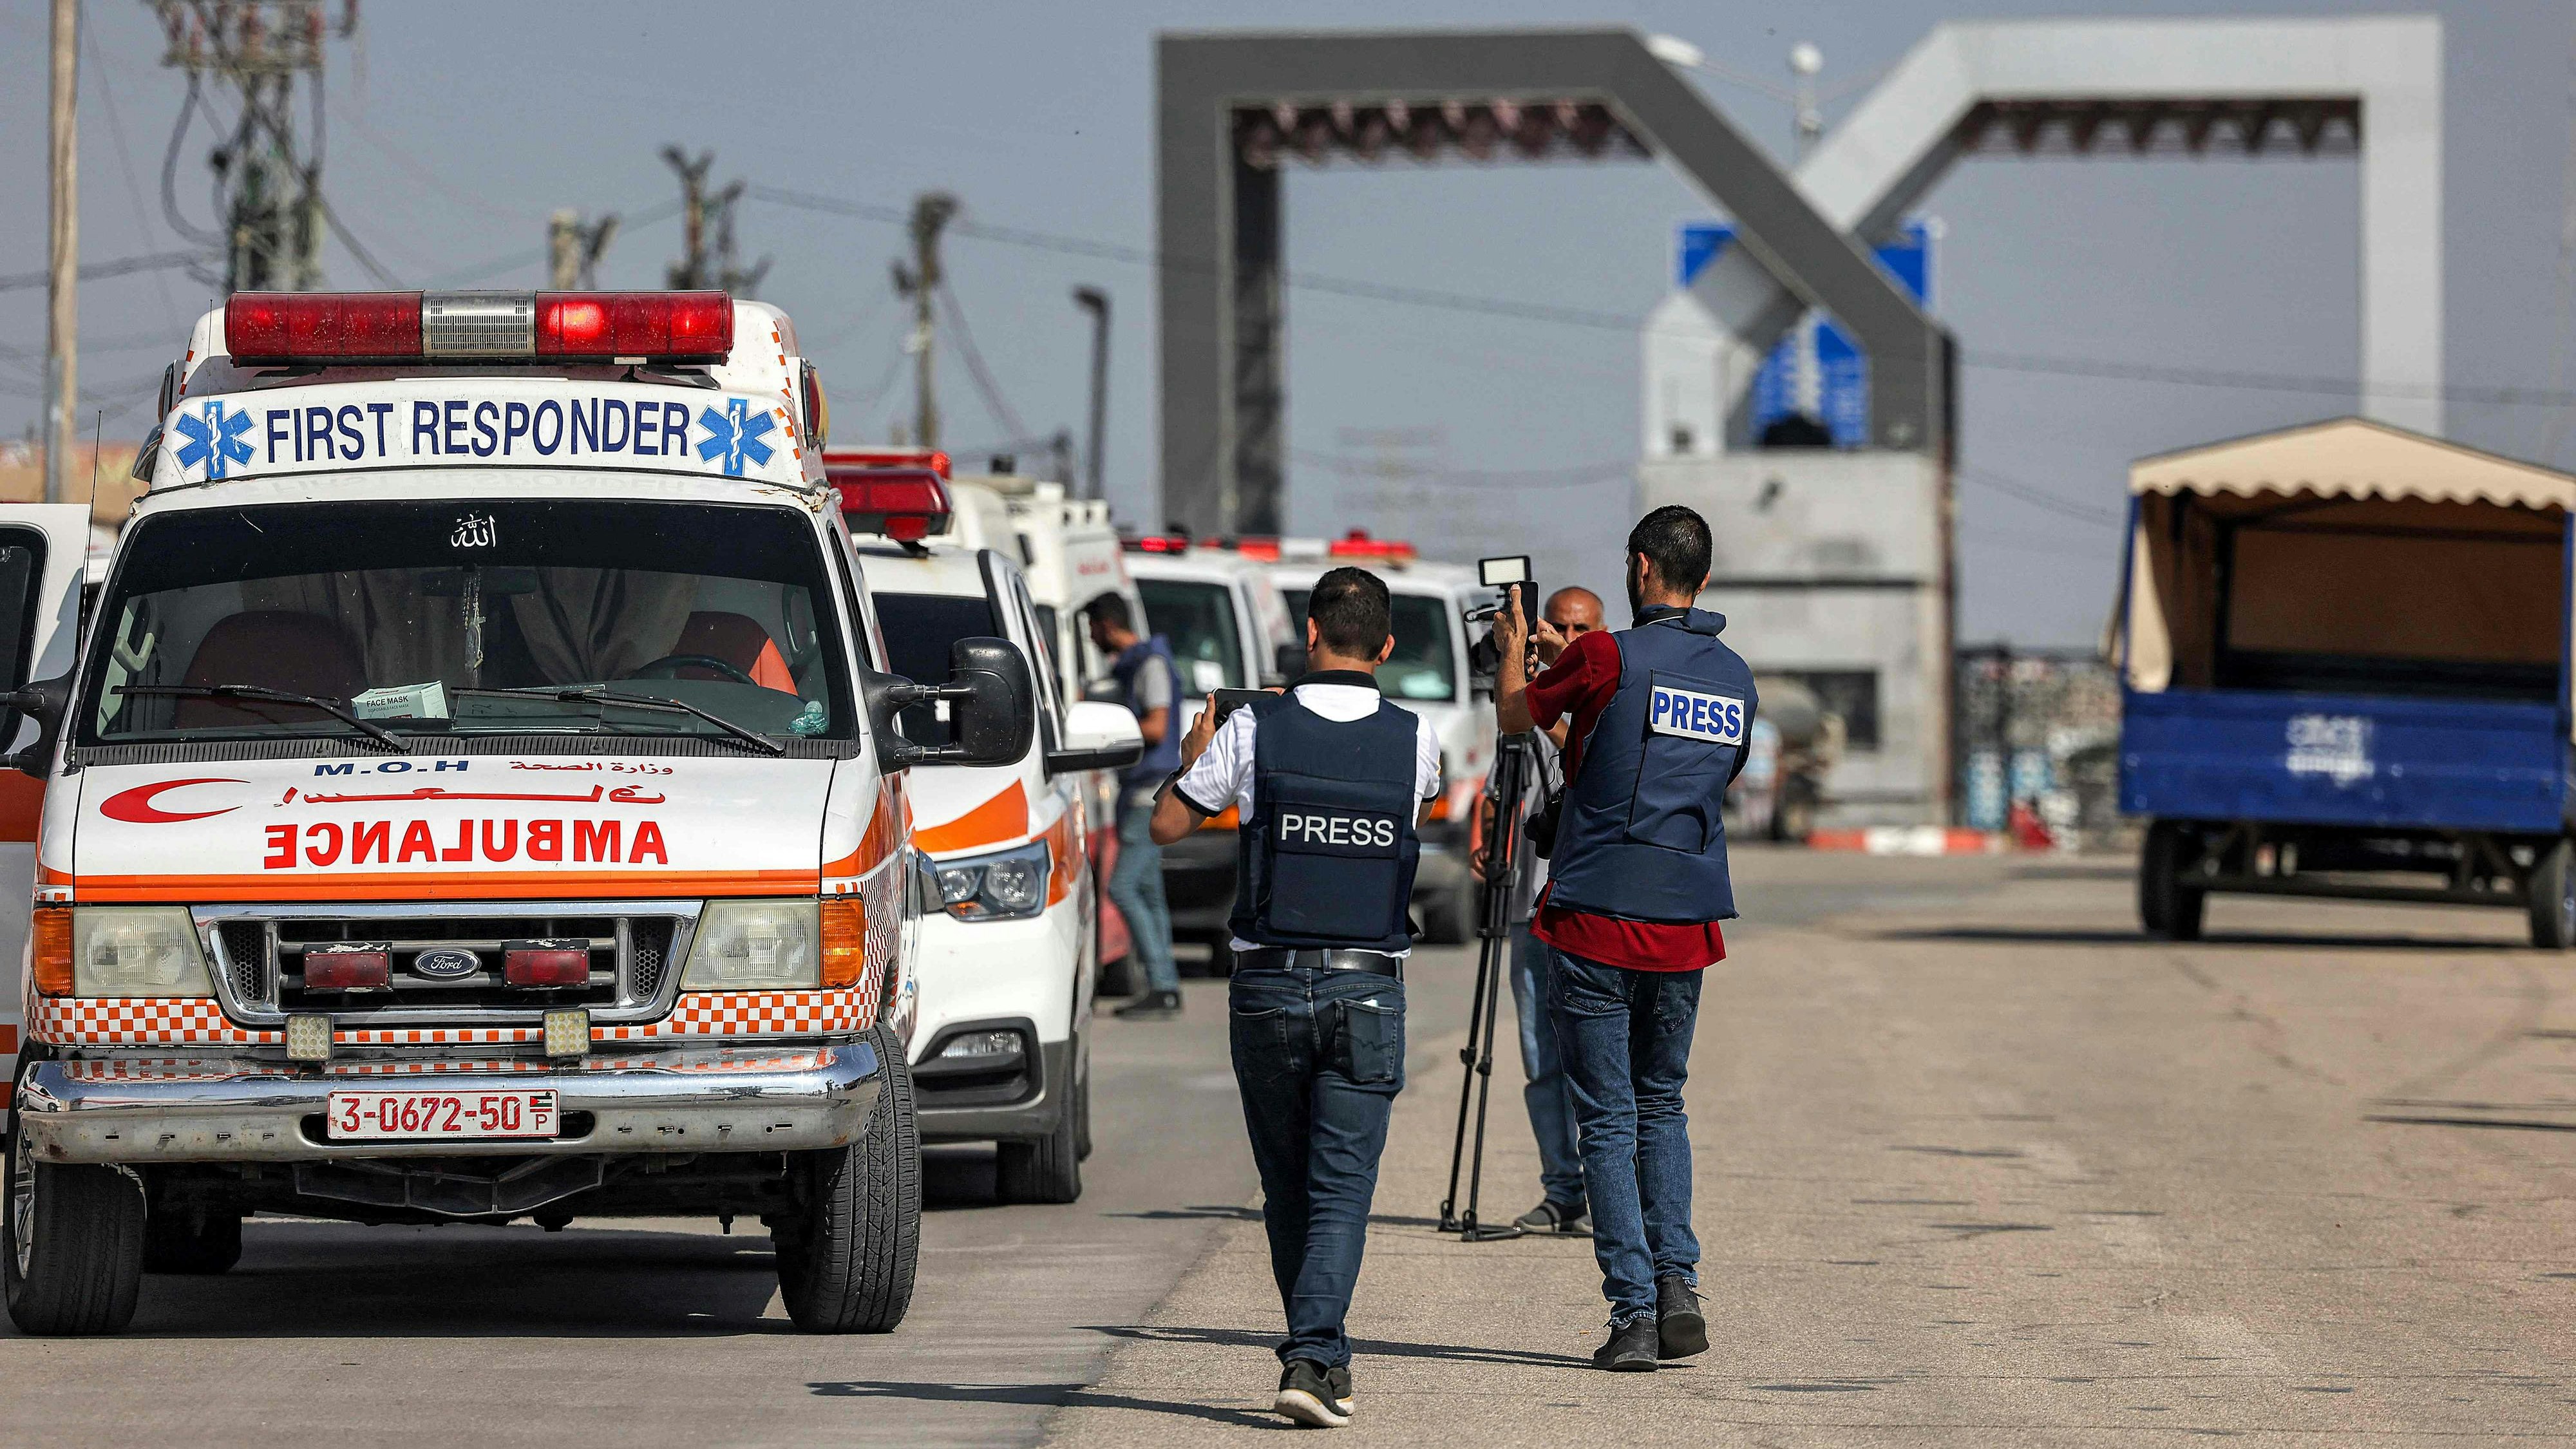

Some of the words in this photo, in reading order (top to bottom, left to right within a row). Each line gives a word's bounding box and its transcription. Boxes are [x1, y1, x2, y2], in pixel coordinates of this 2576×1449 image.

[267, 402, 393, 463] FIRST
[413, 397, 690, 457] RESPONDER
[366, 698, 386, 708] FACE
[387, 695, 409, 705] MASK
[1653, 691, 1741, 738] PRESS
[314, 760, 469, 776] M.O.H
[508, 761, 603, 772] الصحة
[609, 762, 674, 775] وزارة
[1281, 813, 1394, 847] PRESS
[430, 955, 463, 969] Ford
[341, 1096, 522, 1132] 3-0672-50
[535, 1113, 548, 1130] P
